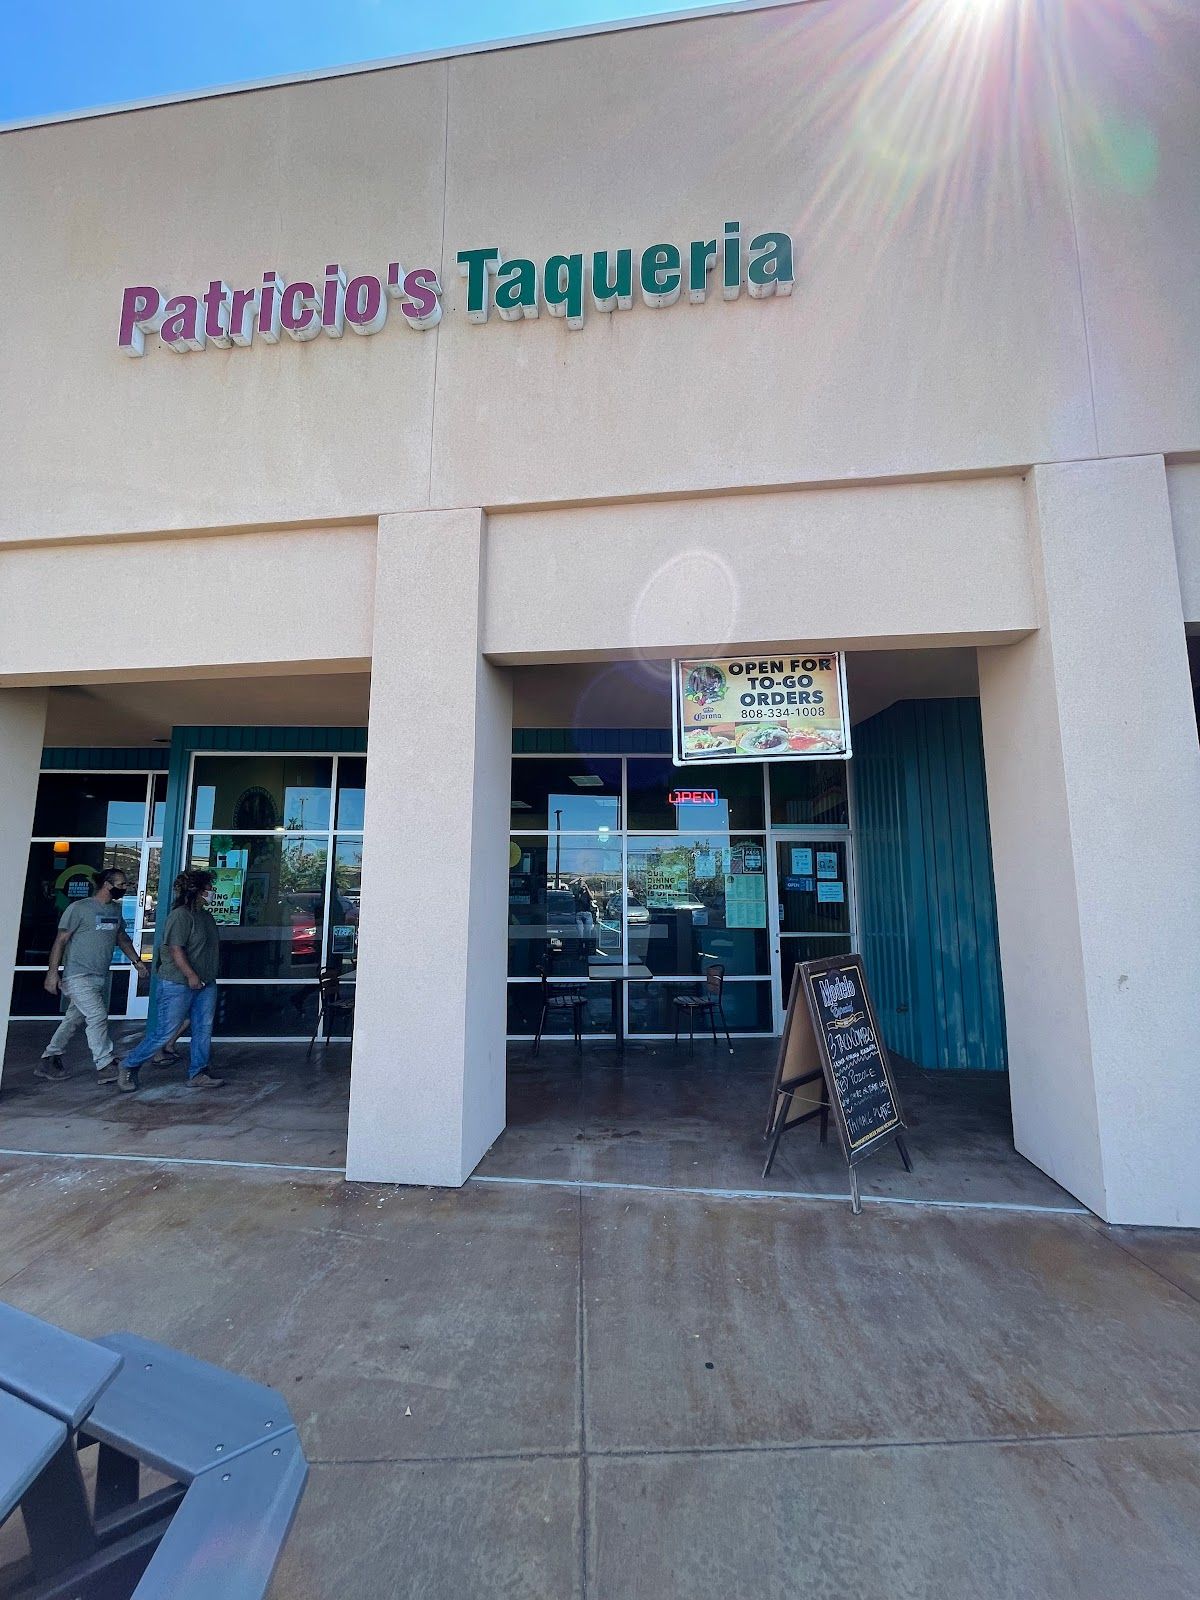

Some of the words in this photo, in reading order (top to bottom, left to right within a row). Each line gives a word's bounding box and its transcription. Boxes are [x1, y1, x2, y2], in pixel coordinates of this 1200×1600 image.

[118, 263, 441, 354] Patricio's
[457, 221, 795, 327] Taqueria
[728, 660, 784, 675] OPEN
[790, 658, 832, 672] FOR
[747, 674, 813, 690] TO-GO
[740, 690, 824, 707] ORDERS
[693, 711, 722, 722] Corona
[741, 707, 825, 719] 808-334-1008
[668, 791, 714, 804] OPEN
[818, 975, 856, 1008] Modelo
